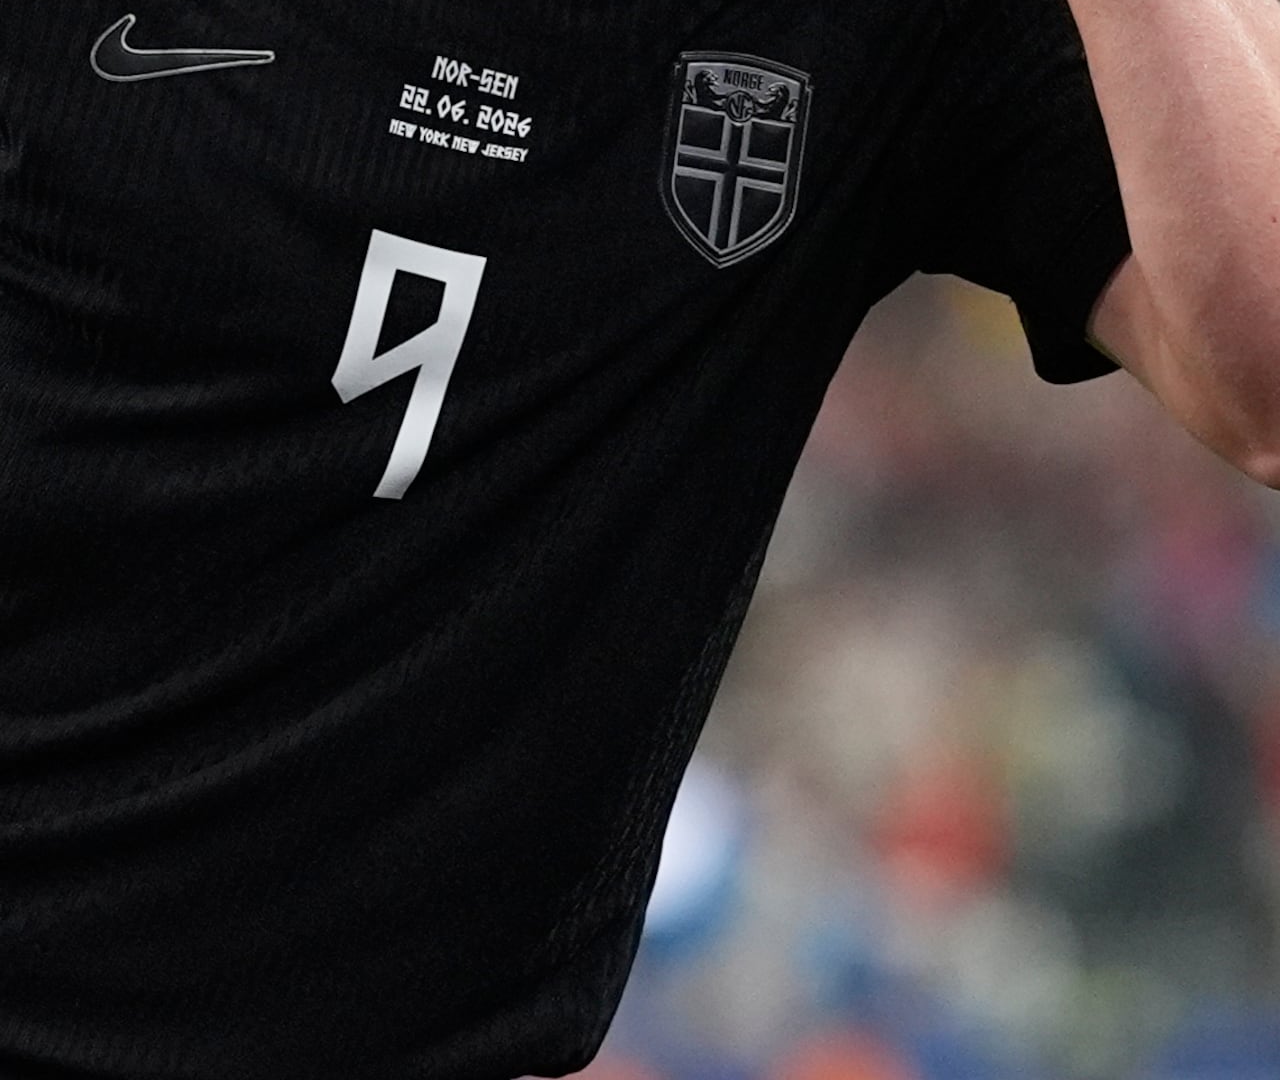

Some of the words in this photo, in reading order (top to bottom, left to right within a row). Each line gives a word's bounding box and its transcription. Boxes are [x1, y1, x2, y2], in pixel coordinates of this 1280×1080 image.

[431, 55, 519, 100] NOR-SEN
[723, 69, 764, 90] NORGE
[388, 118, 417, 138] NEW
[419, 126, 451, 148] YORK
[451, 135, 480, 154] NEW
[481, 143, 529, 162] JERSEY
[476, 105, 532, 138] 2026
[331, 228, 487, 500] 9
